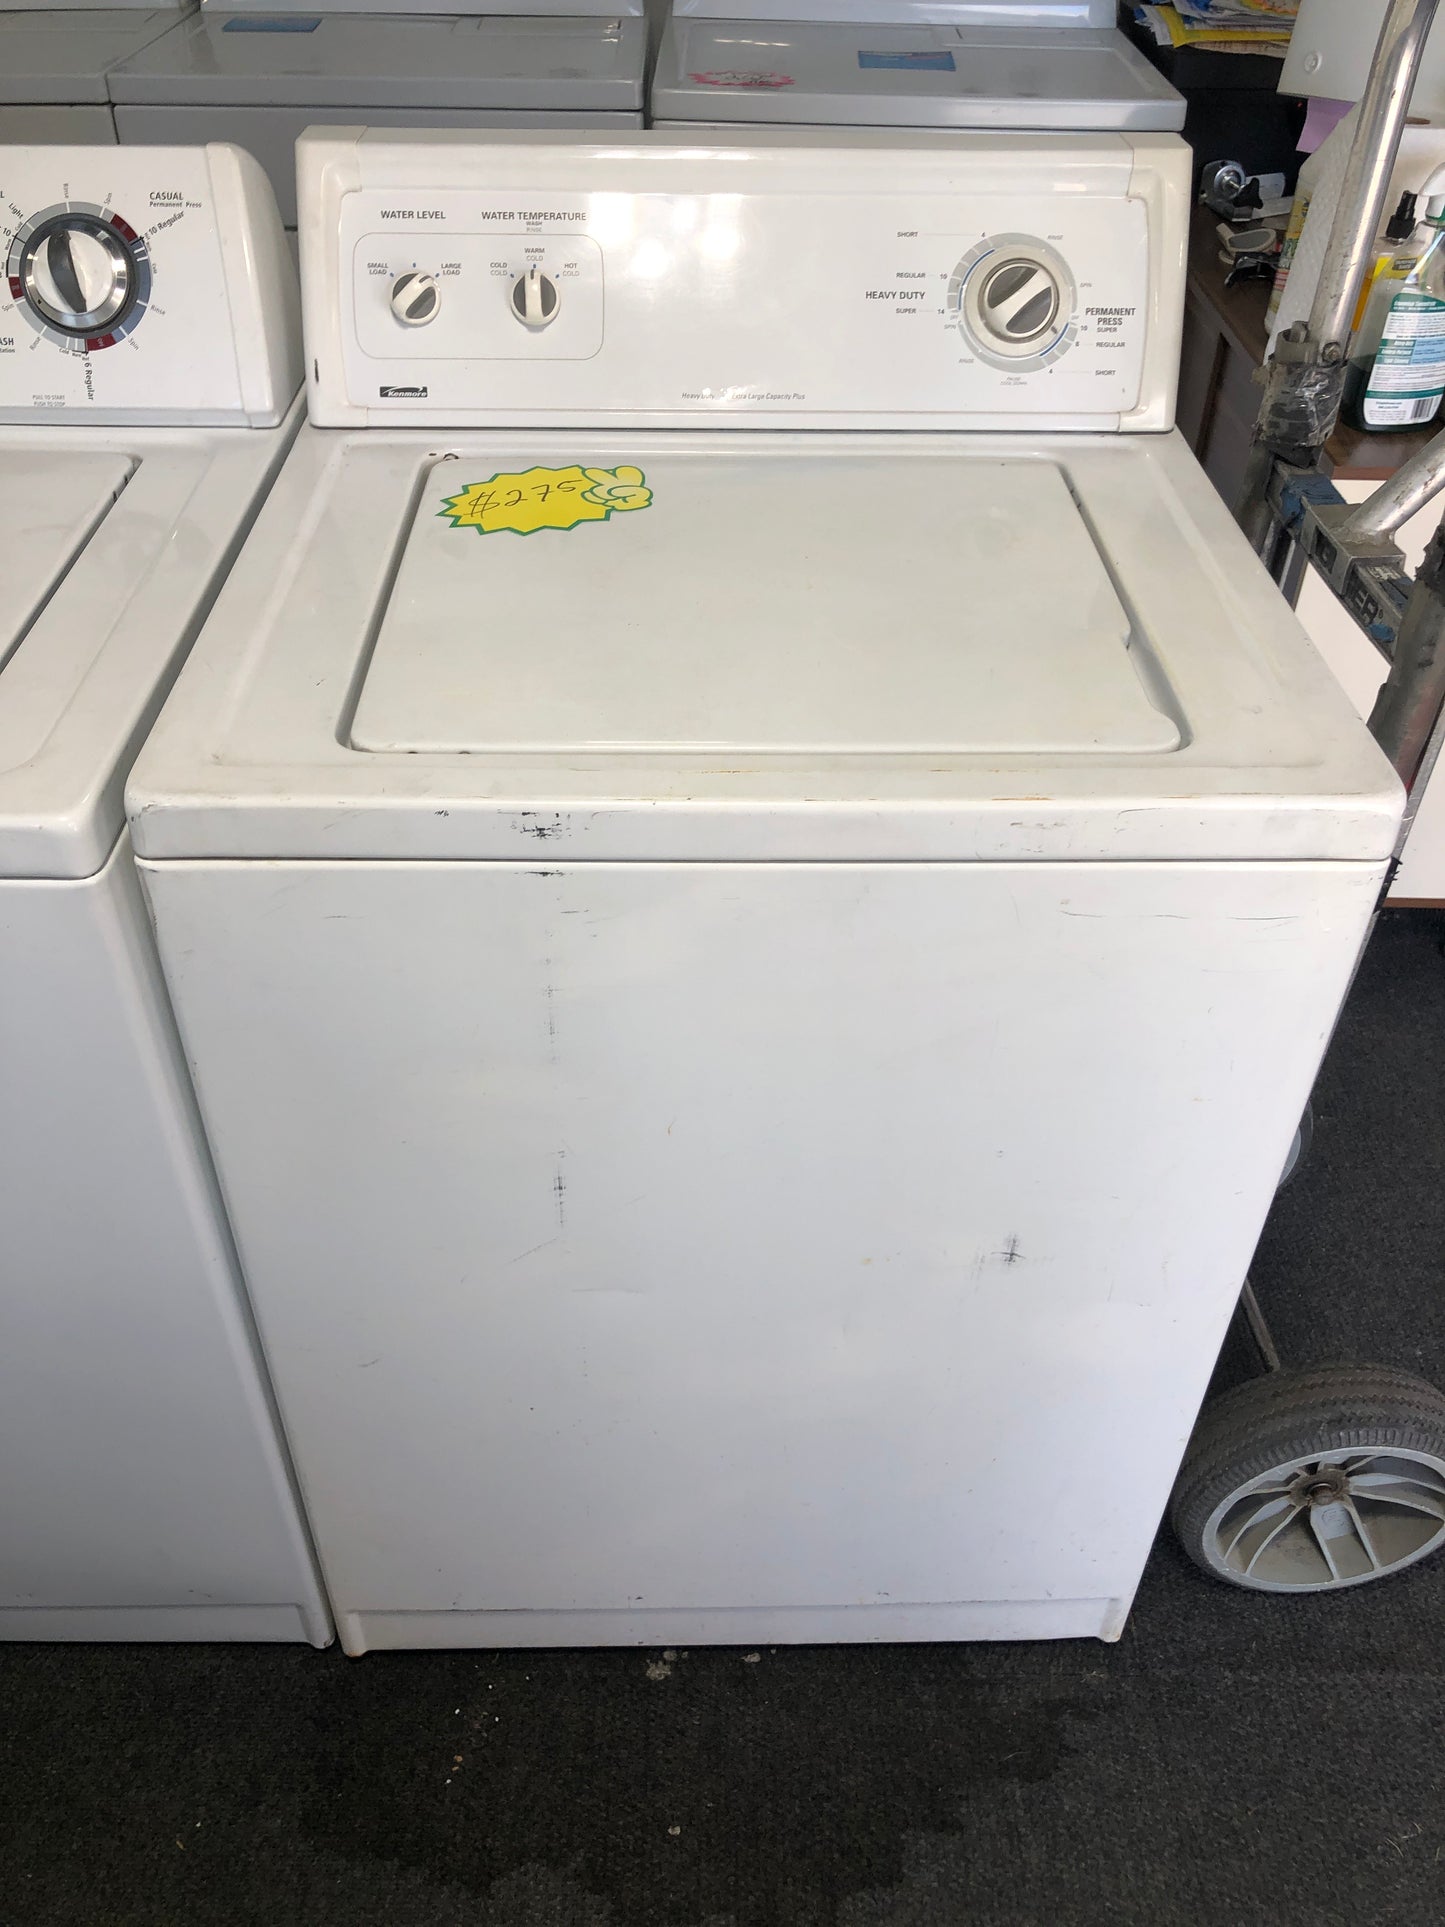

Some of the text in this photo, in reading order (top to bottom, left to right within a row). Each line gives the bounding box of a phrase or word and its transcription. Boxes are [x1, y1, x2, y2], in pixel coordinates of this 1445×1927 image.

[149, 192, 183, 200] CASUAL
[8, 203, 24, 219] Light
[380, 210, 446, 220] WATER LEVEL
[481, 212, 587, 221] WATER TEMPERATURE
[148, 210, 185, 236] 10 Regular
[3, 228, 11, 236] 10
[865, 291, 926, 300] HEAVY DUTY
[1, 303, 15, 312] Spin
[150, 304, 166, 316] Rinse
[1085, 308, 1136, 316] PERMANENT
[1097, 317, 1123, 326] PRESS
[0, 338, 14, 346] ASH
[128, 337, 140, 351] Spin
[84, 369, 95, 400] Regular
[681, 392, 701, 400] Heavy
[766, 393, 792, 401] Capacity
[463, 479, 585, 519] $275
